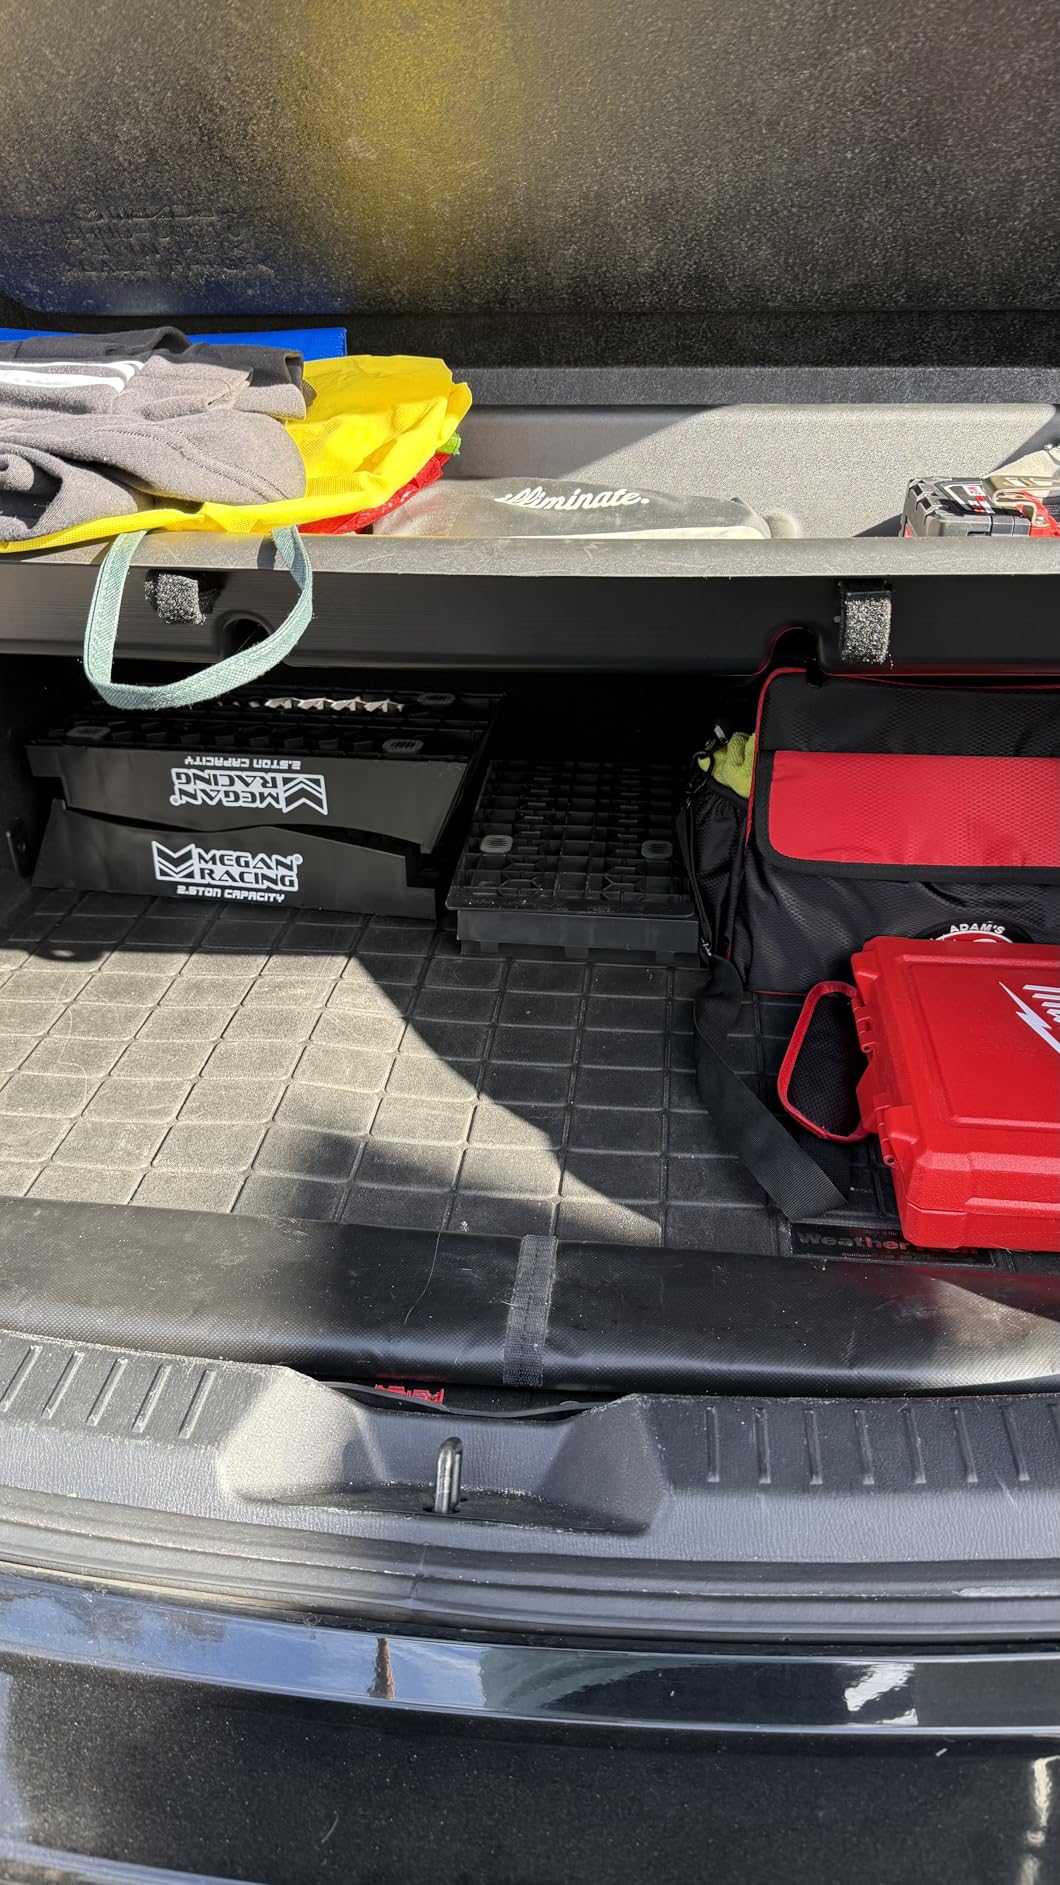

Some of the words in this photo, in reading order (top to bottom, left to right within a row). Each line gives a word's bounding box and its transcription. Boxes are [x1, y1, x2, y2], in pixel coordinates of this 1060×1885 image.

[184, 755, 250, 768] CAPACITY
[173, 770, 280, 790] RACING
[199, 867, 297, 889] RACING
[223, 889, 286, 903] CAPACITY
[950, 923, 1006, 935] ADAM'S
